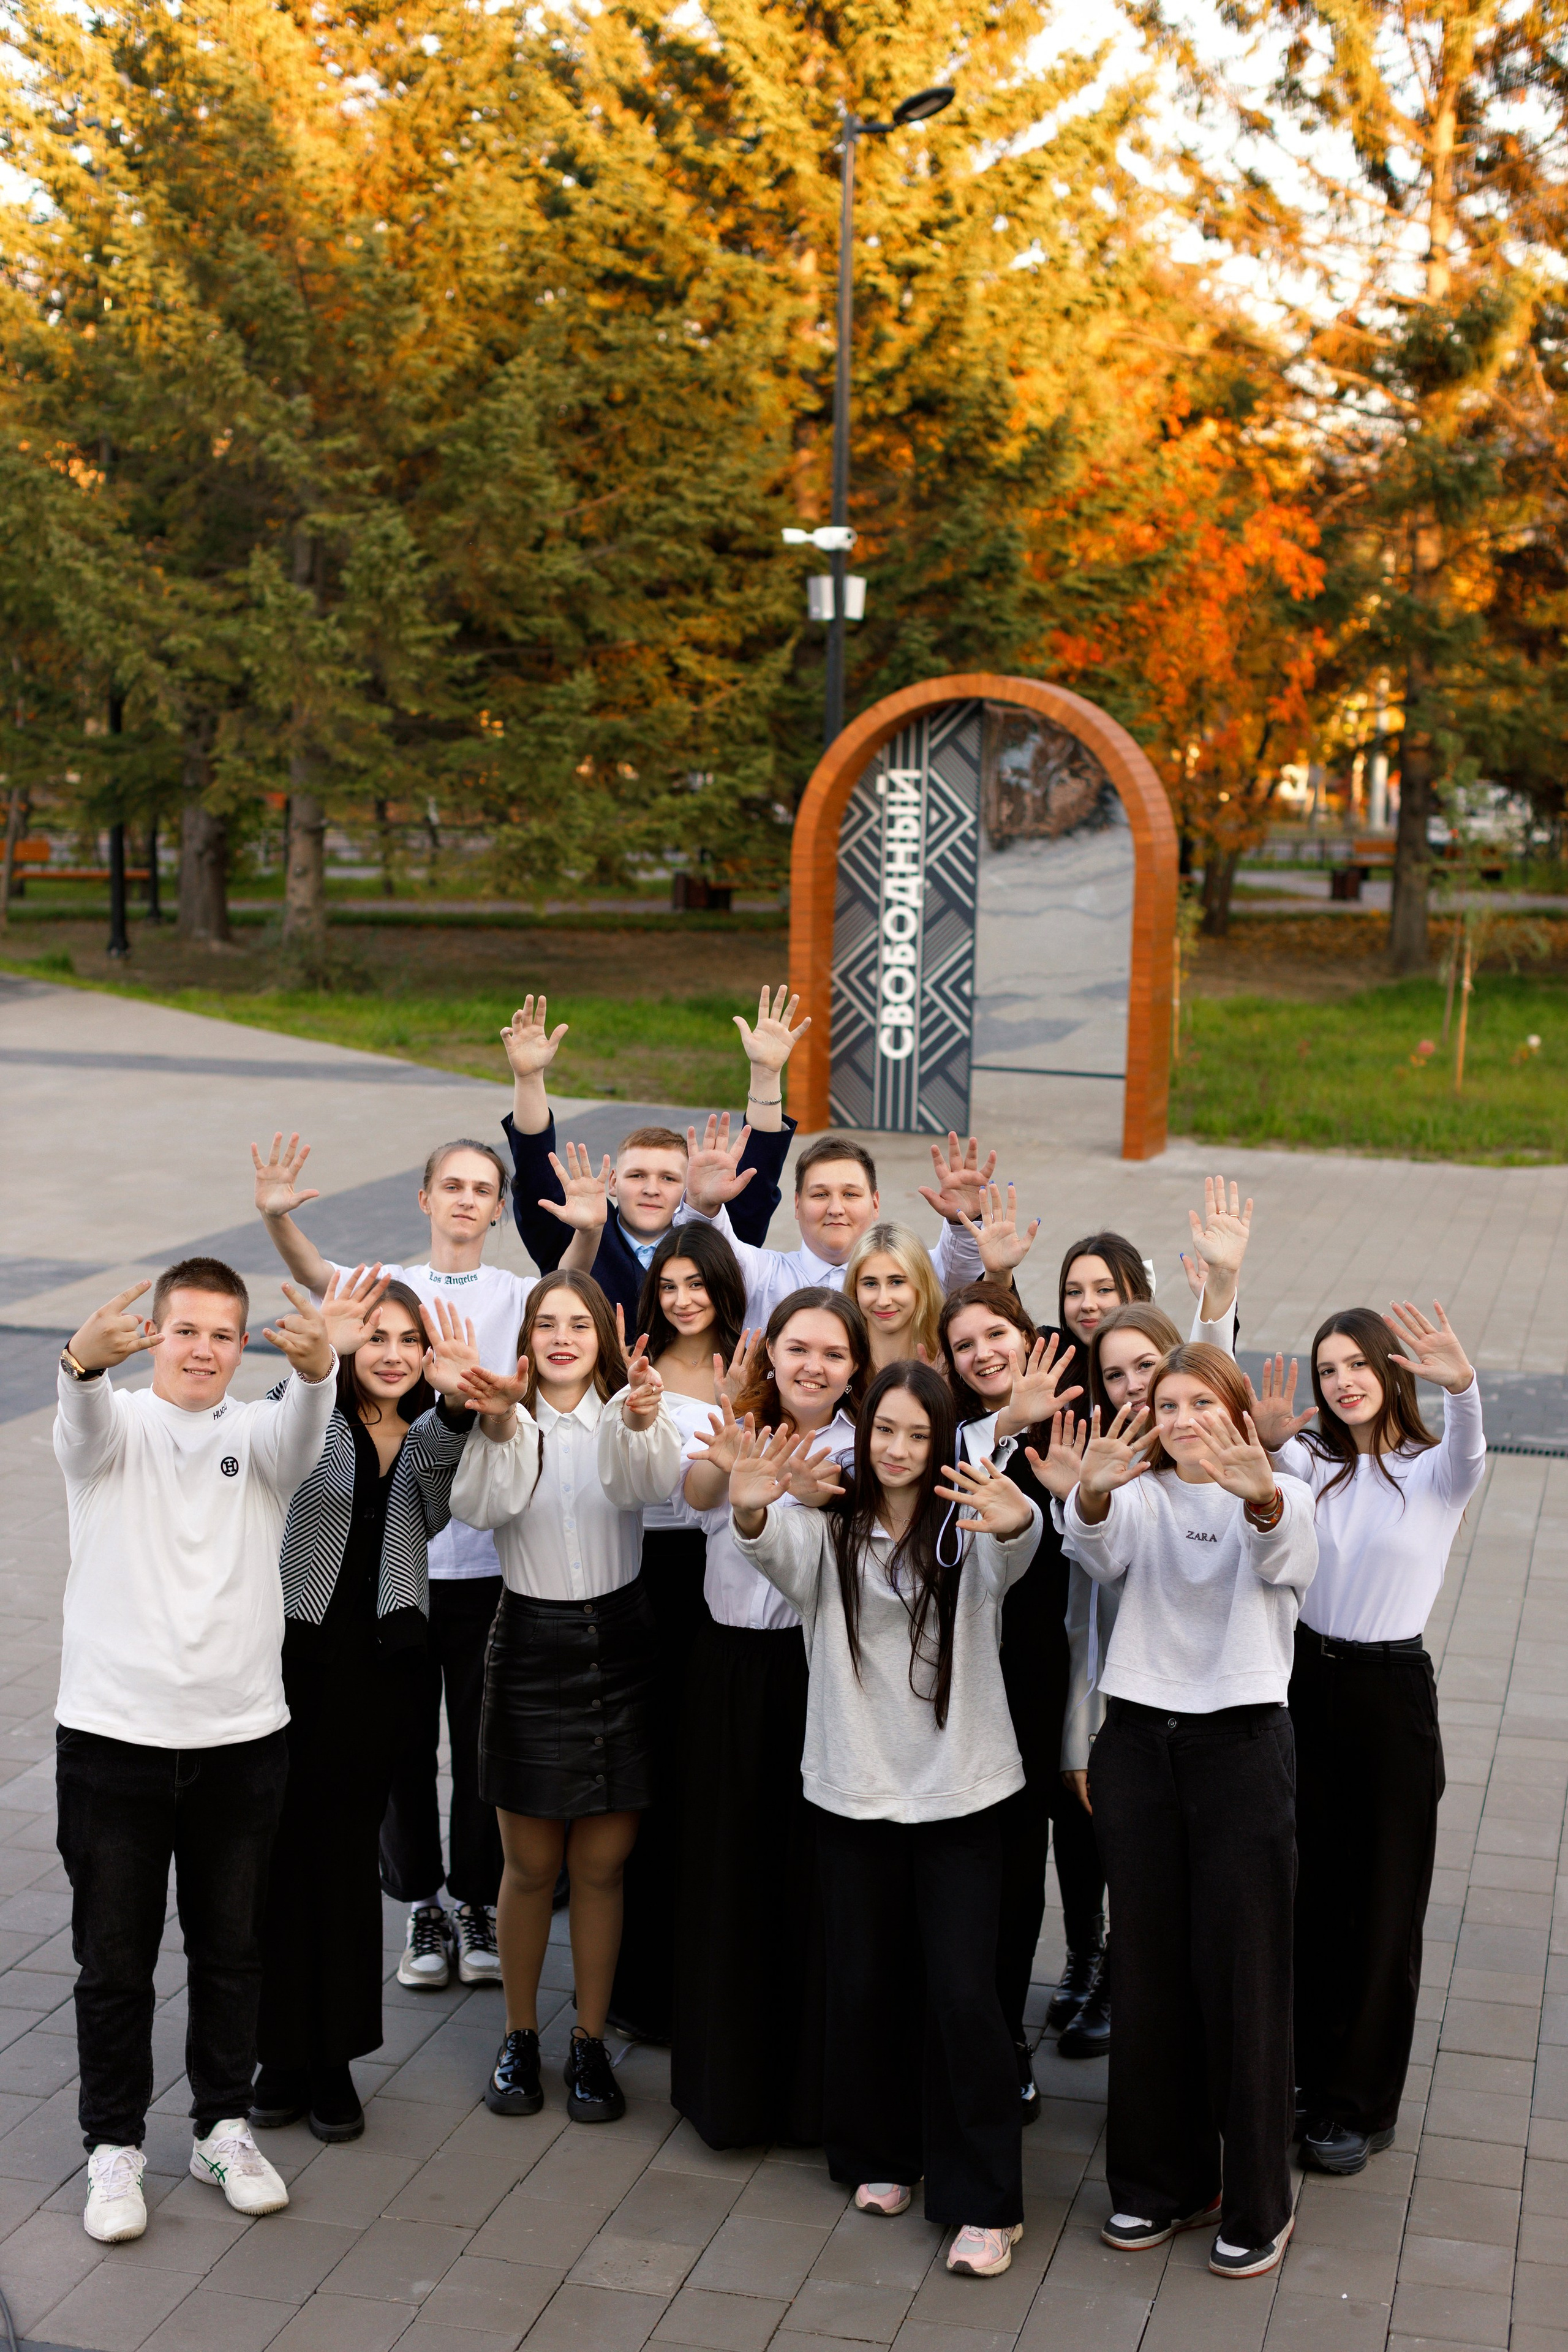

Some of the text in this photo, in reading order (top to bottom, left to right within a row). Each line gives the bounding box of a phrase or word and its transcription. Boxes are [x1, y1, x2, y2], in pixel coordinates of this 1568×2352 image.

[876, 769, 924, 1060] СВОБОДНЫЙ
[429, 1271, 478, 1285] Los Angeles
[1186, 1531, 1217, 1542] ZARA
